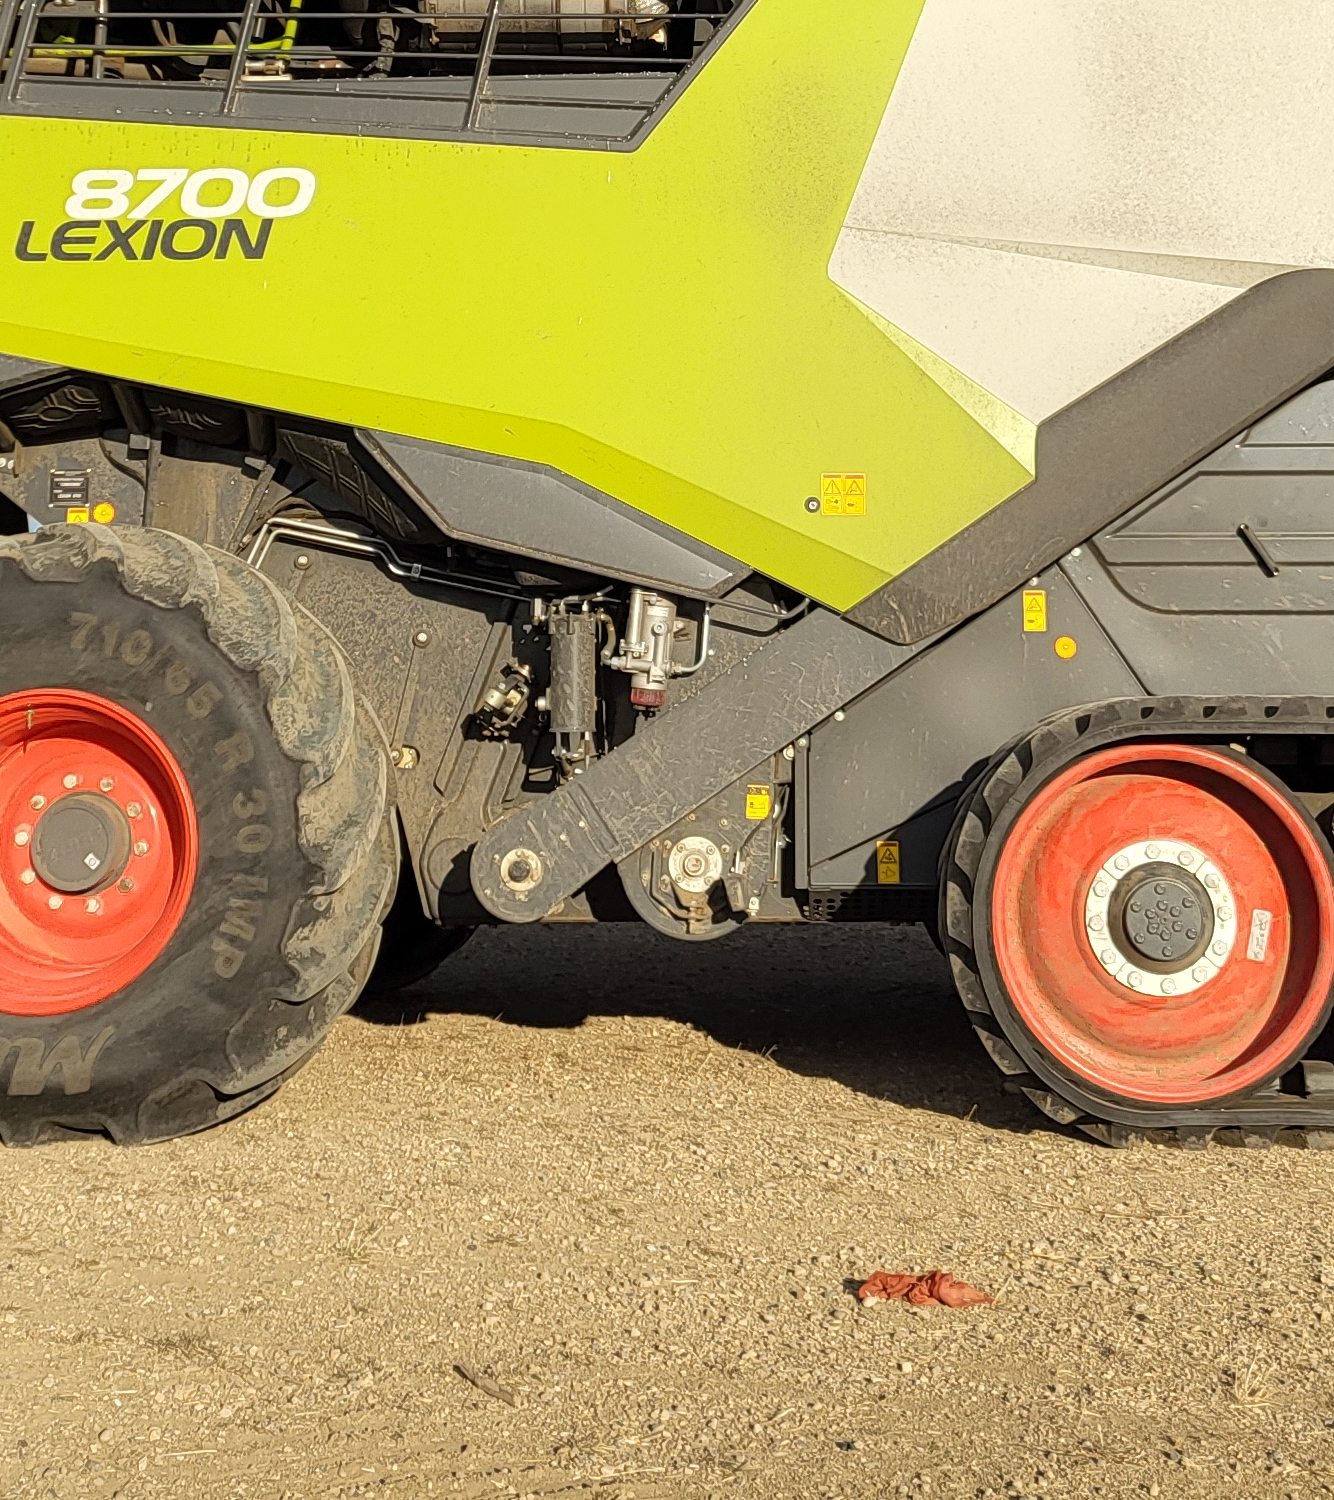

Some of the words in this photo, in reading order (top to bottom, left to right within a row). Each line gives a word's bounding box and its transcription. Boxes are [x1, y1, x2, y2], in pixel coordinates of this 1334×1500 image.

[64, 167, 316, 219] 8700
[15, 218, 274, 261] LEXION
[215, 732, 255, 773] R
[232, 787, 275, 855] 30
